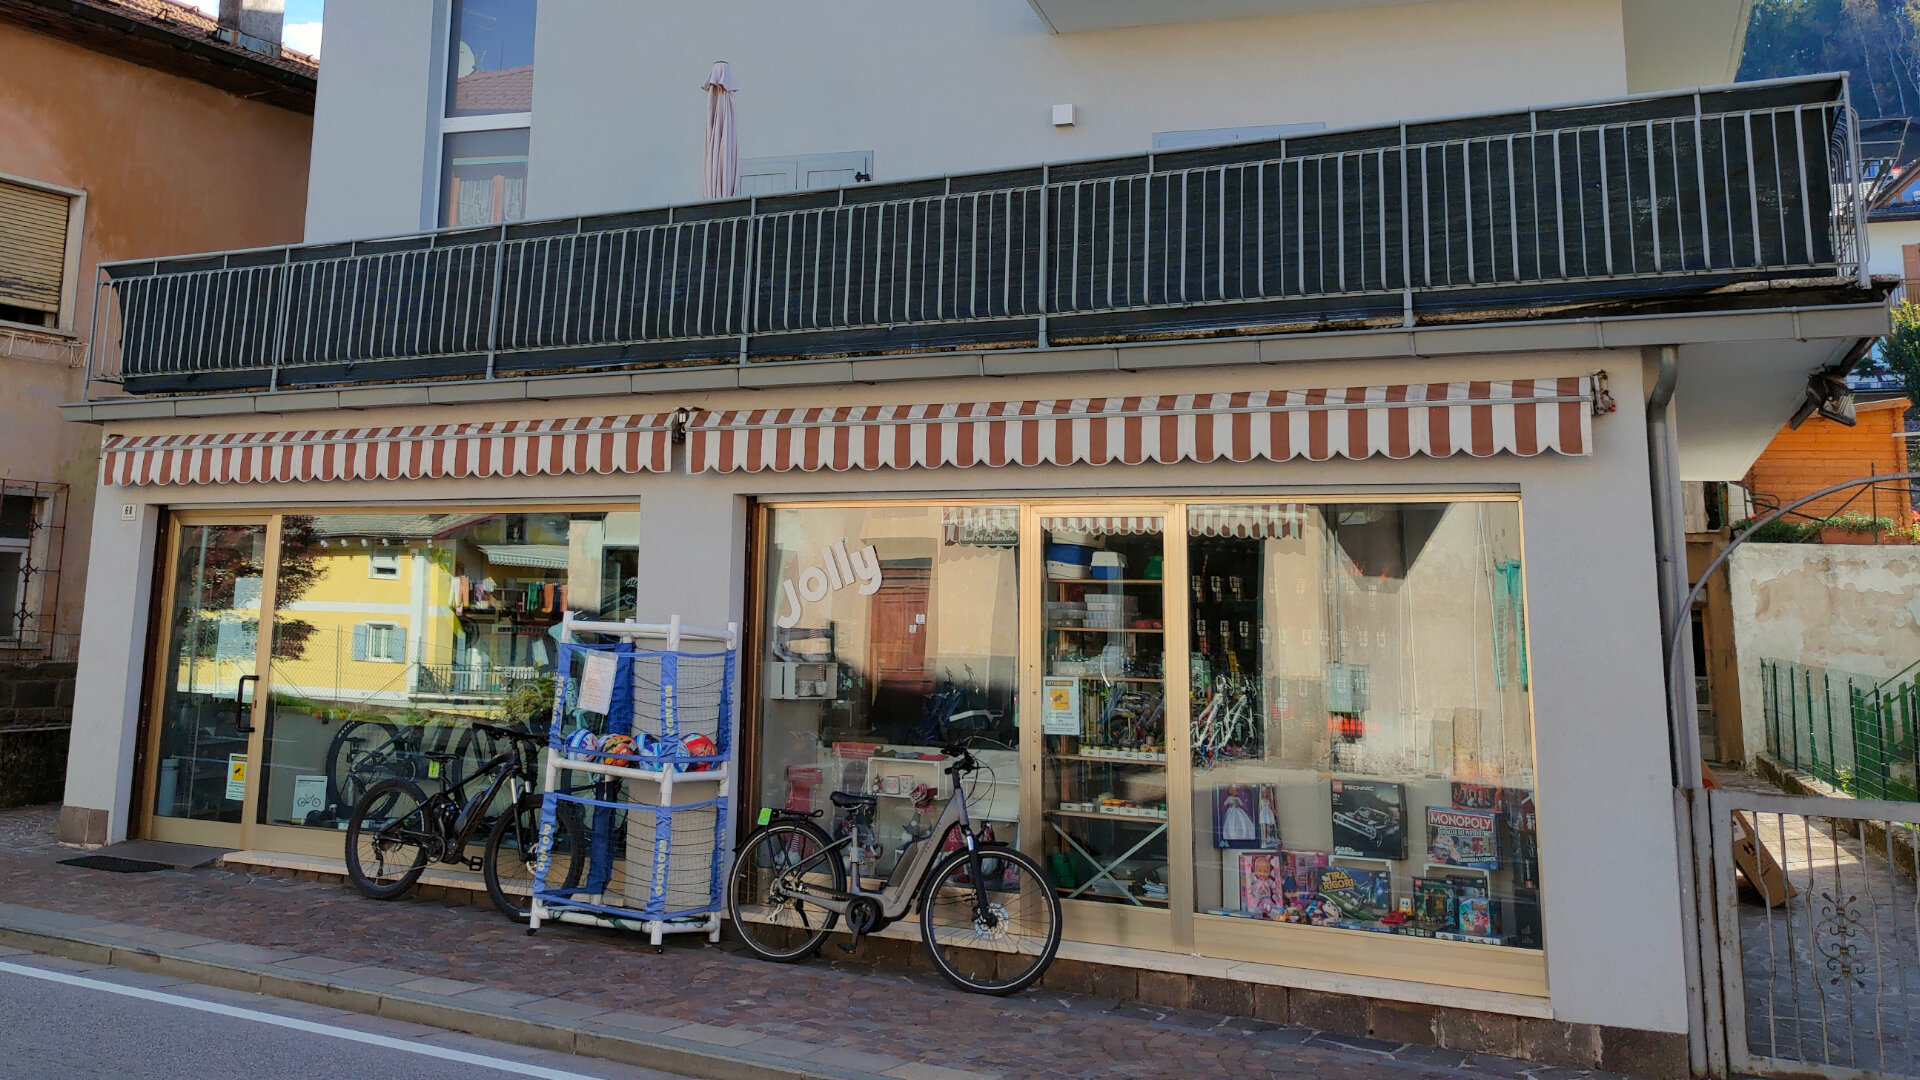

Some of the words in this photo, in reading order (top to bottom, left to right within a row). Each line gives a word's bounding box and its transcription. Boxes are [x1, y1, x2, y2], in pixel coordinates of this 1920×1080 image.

[124, 506, 133, 515] 68
[992, 533, 1017, 541] bambino
[1430, 812, 1491, 830] MONOPOLY
[655, 840, 667, 896] MONDO
[1325, 870, 1348, 880] TIRA
[1322, 878, 1355, 891] RIGORI
